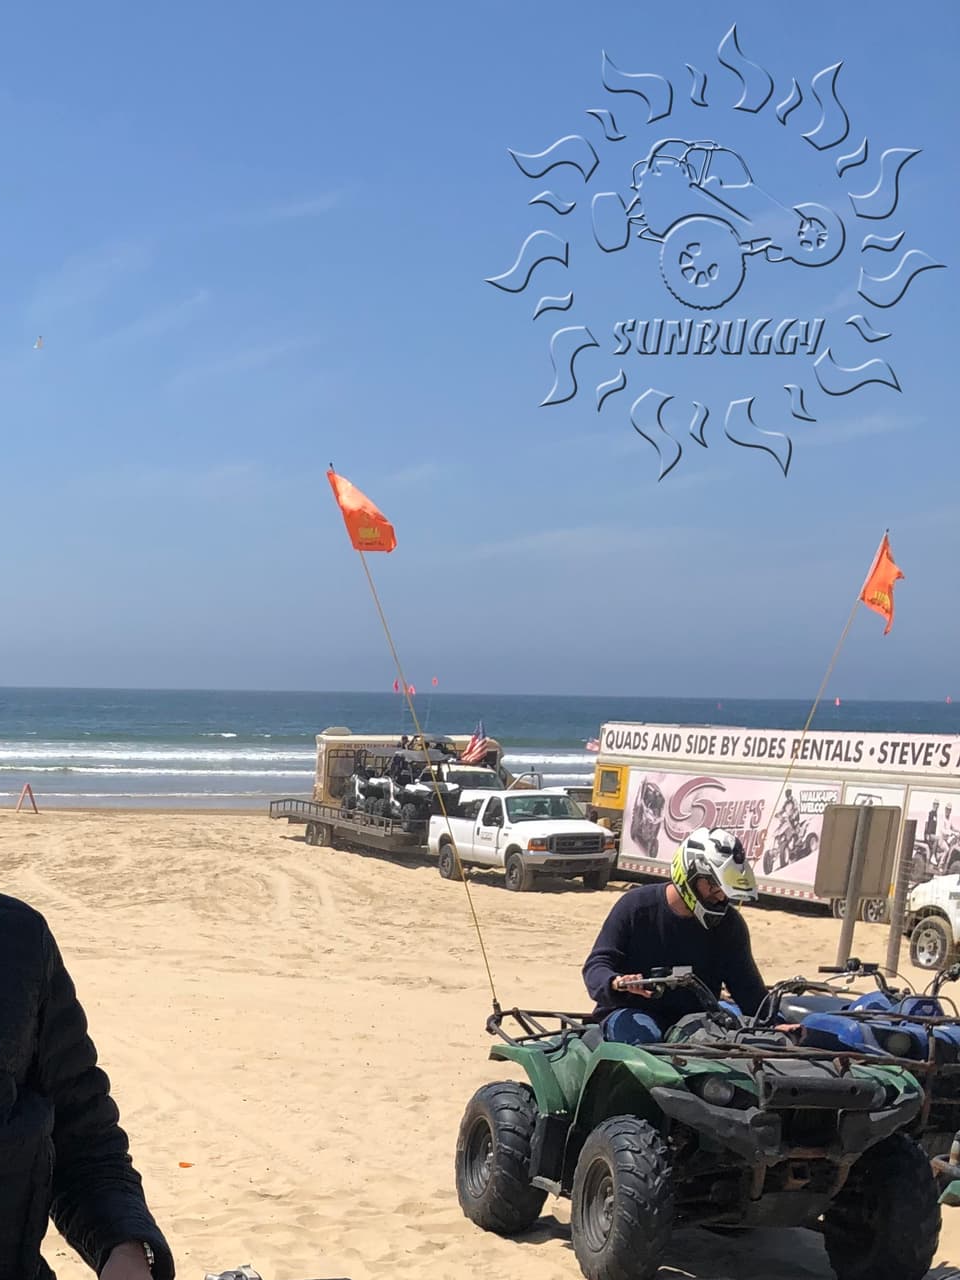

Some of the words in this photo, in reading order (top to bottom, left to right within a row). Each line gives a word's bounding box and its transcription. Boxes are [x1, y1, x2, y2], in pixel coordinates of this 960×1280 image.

[605, 729, 649, 751] QUADS
[651, 732, 682, 753] AND
[685, 734, 717, 755] SIDE
[720, 735, 741, 757] BY
[742, 736, 787, 759] SIDES
[790, 738, 864, 763] RENTALS
[877, 740, 952, 768] STEVE'S
